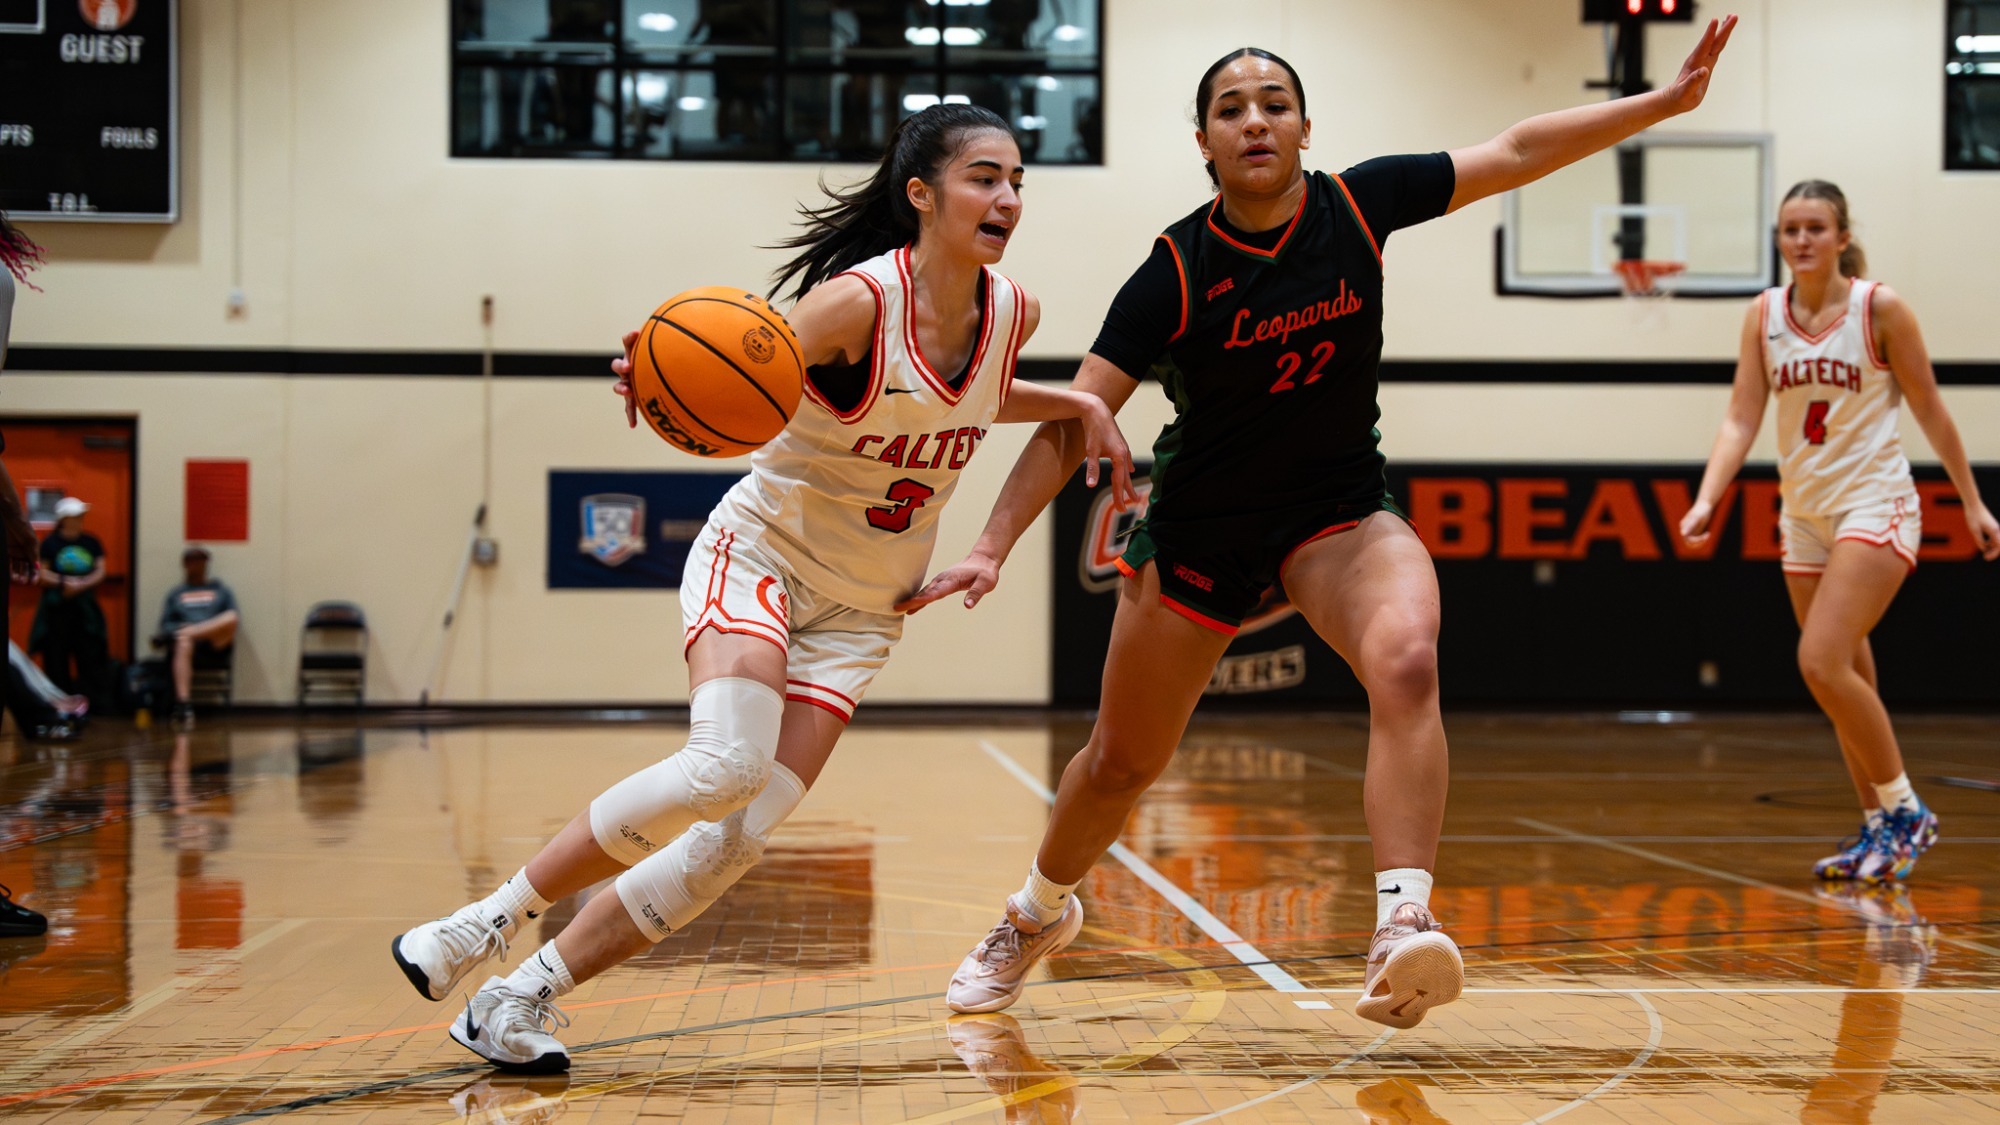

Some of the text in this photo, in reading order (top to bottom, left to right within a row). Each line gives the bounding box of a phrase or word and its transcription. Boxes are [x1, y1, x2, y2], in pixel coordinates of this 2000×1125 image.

[60, 33, 145, 64] GUEST
[101, 126, 159, 150] FOULS
[1224, 278, 1362, 349] Leopards
[1269, 340, 1336, 394] 22
[645, 397, 721, 457] NCAA
[850, 425, 988, 470] CALTEC
[1803, 399, 1830, 446] 4
[865, 477, 935, 534] 3
[1408, 477, 1980, 561] BEAVES
[1173, 562, 1214, 593] RIDGE
